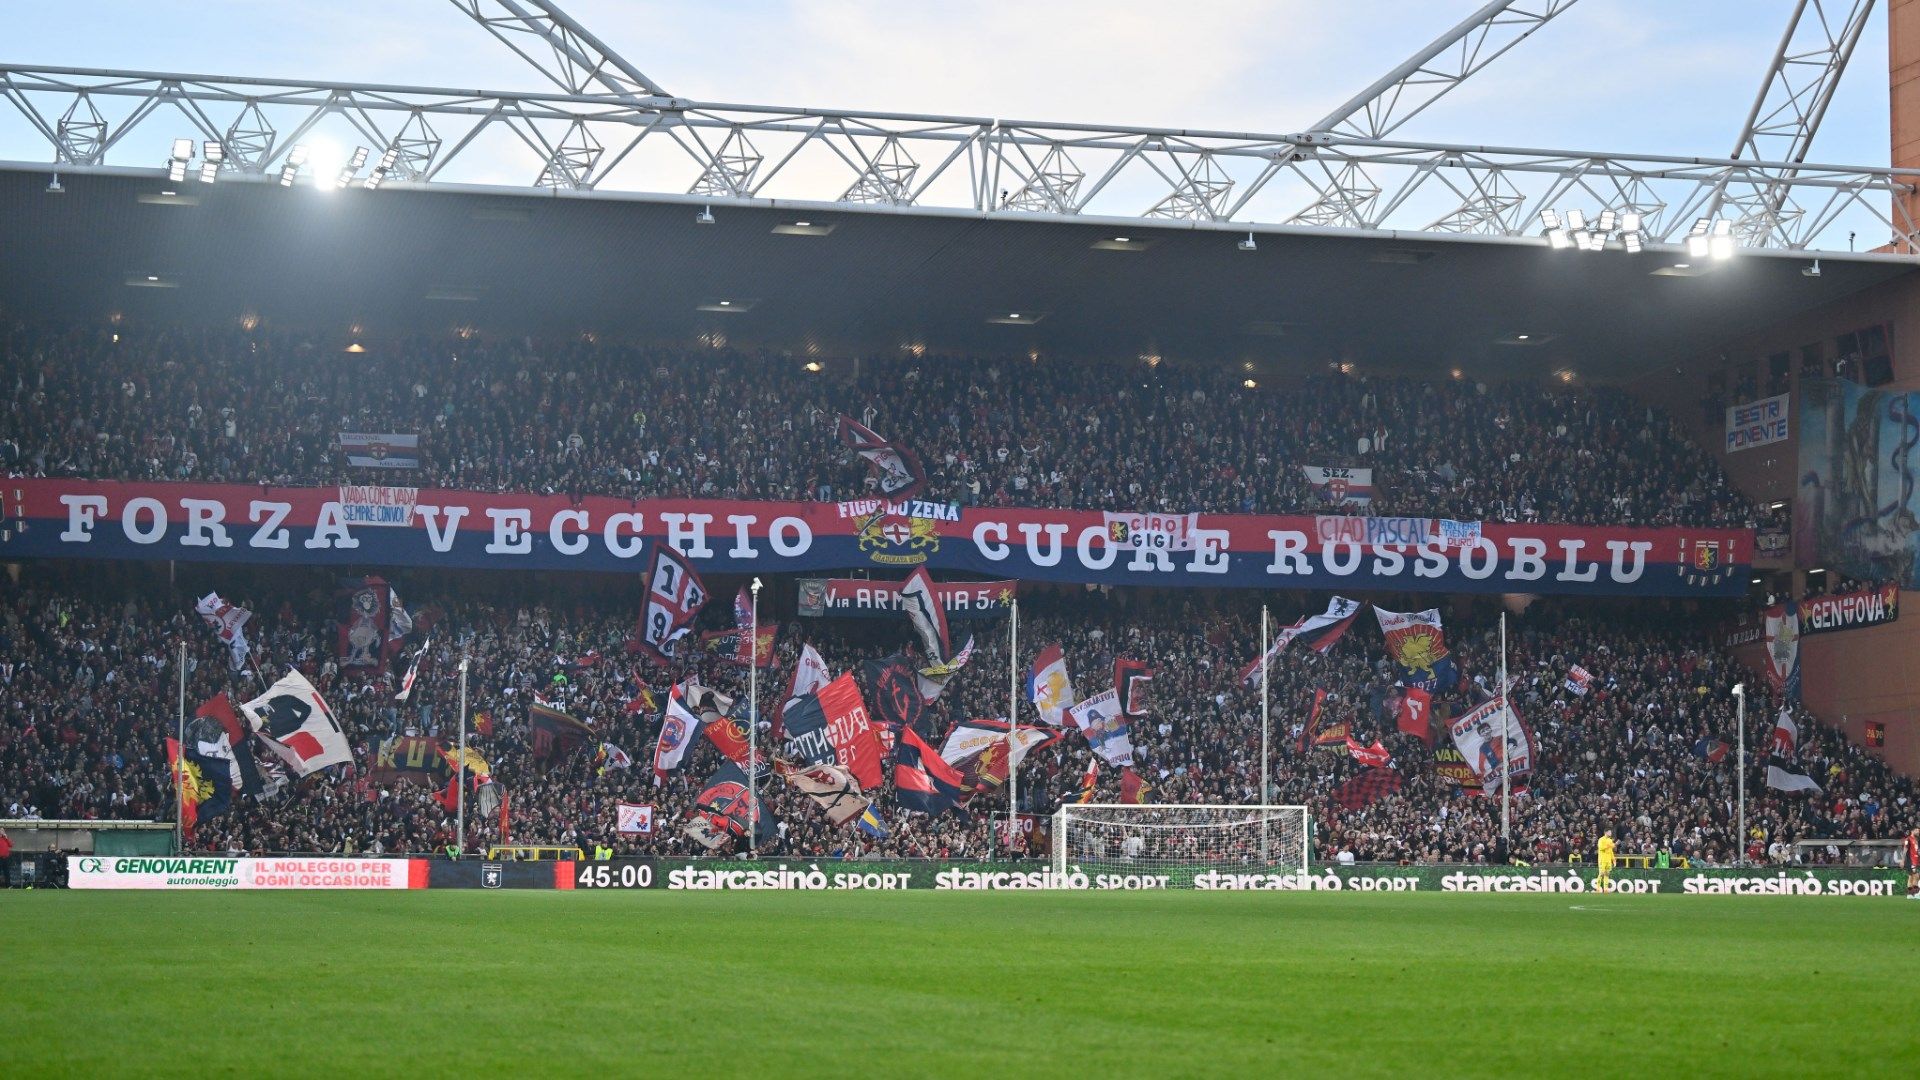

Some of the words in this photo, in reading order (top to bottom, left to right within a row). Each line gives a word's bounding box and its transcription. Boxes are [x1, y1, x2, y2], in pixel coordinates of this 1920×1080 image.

[1735, 400, 1780, 426] SESTRI
[1728, 419, 1786, 449] PONENTE
[1322, 467, 1354, 479] SEZ.
[342, 486, 367, 504] VADA
[368, 486, 392, 505] COME
[393, 487, 415, 506] VADA
[343, 505, 377, 521] SEMPRE
[912, 500, 959, 522] ZENA
[1131, 517, 1176, 532] CIAO
[1319, 517, 1364, 543] CIAO
[1366, 517, 1428, 545] PASCAL
[60, 494, 359, 549] FORZA
[415, 504, 813, 559] VECCHIO
[1266, 529, 1653, 584] ROSSOBLU
[1132, 534, 1174, 549] GIGI
[1811, 593, 1885, 629] GENOVA
[114, 858, 238, 875] GENOVARENT
[255, 862, 269, 873] IL
[275, 862, 357, 874] NOLEGGIO
[361, 862, 392, 873] PER
[167, 876, 239, 887] autonoleggio
[255, 875, 296, 886] OGNI
[301, 875, 392, 887] OCCASIONE
[578, 864, 652, 888] 45:00
